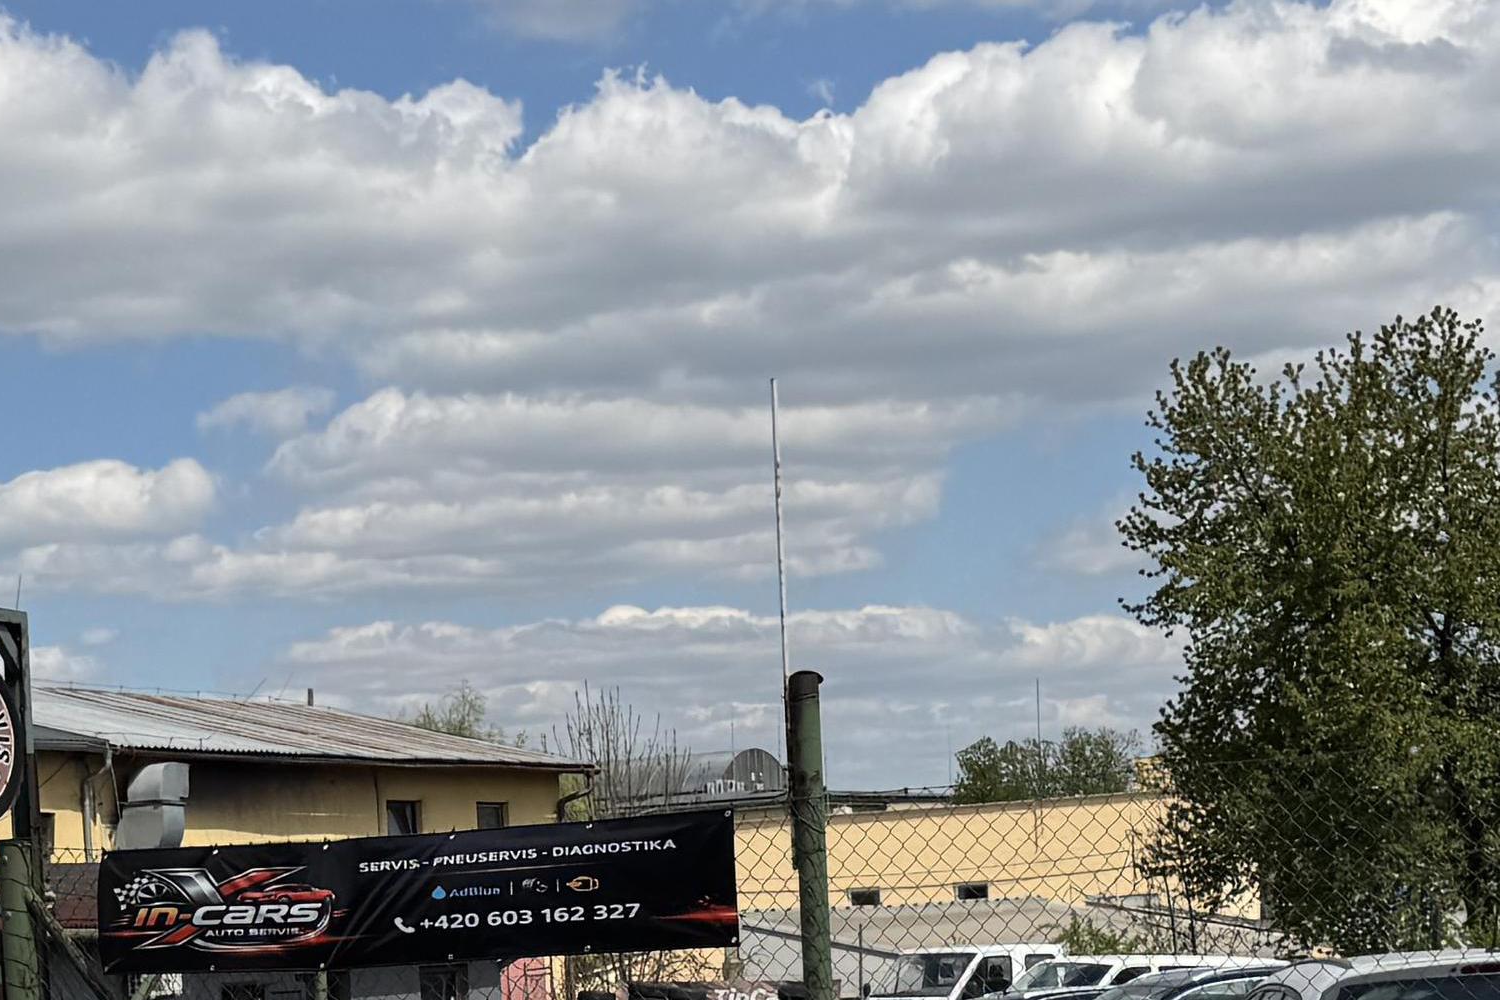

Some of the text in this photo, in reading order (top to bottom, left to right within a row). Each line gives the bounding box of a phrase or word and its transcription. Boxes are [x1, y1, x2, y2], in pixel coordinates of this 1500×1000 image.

[359, 858, 420, 873] SERVIS
[433, 848, 537, 867] PNEUSERVIS
[552, 839, 677, 857] DIAGNOSTIKA
[420, 903, 640, 930] +420 603 162 327
[205, 928, 244, 937] AUTO
